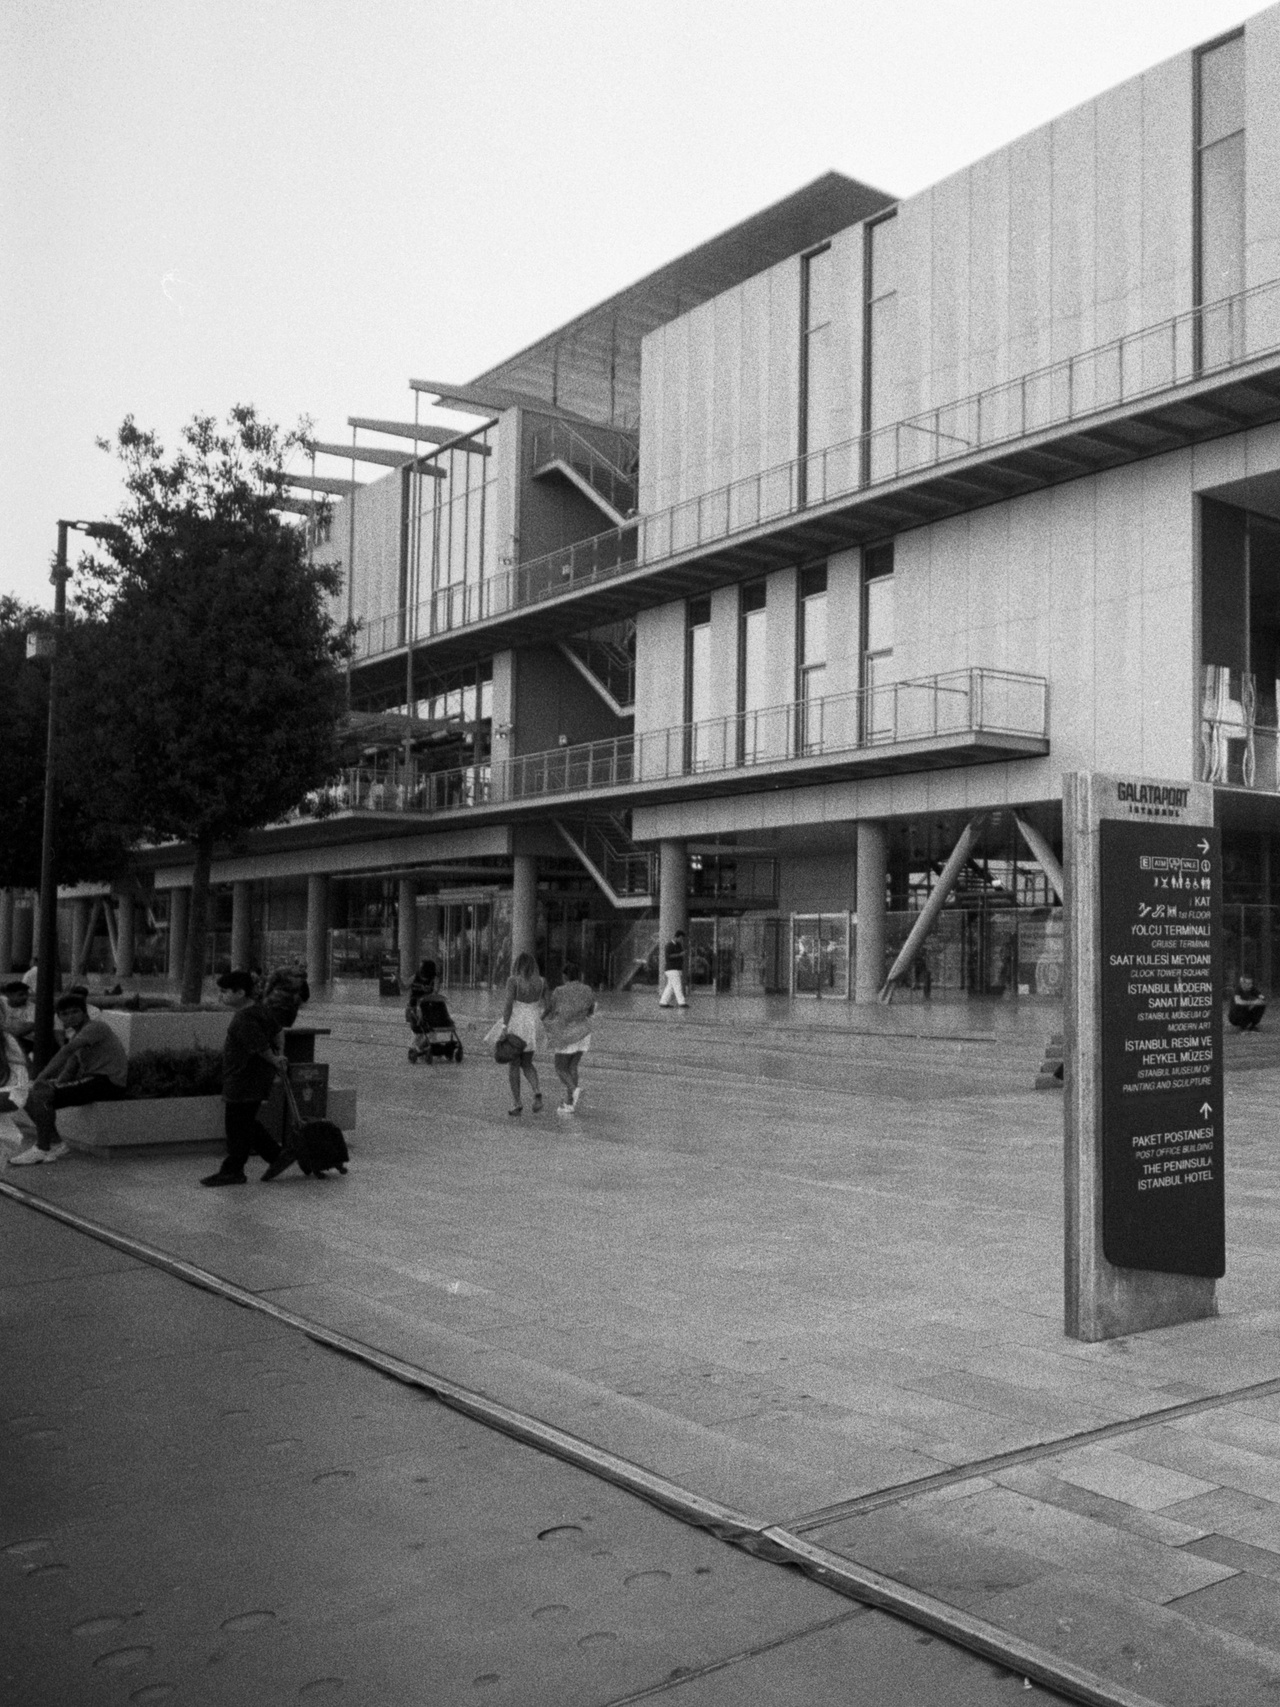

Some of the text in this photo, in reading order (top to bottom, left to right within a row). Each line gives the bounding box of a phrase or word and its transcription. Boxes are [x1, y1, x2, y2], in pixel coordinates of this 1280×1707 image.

[1118, 782, 1190, 808] GALATAPORT
[1194, 896, 1211, 907] KAT
[1188, 910, 1211, 919] FLOOR
[1131, 923, 1211, 936] YOLCU TERMİNALİ
[1151, 940, 1177, 948] CRUISE
[1109, 952, 1211, 966] SAAT KULESİ MEYDANI
[1130, 968, 1210, 978] CLOCK TOWER SQUARE
[1173, 982, 1213, 994] MODERN
[1148, 998, 1178, 1009] SANAT
[1167, 1022, 1212, 1032] MODERN ART
[1171, 1035, 1200, 1048] RESİM
[1200, 1035, 1213, 1046] VE
[1142, 1053, 1178, 1065] HEYKEL
[1122, 1077, 1211, 1093] PAINTING AND SCULPTURE
[1132, 1134, 1162, 1147] PAKET
[1136, 1142, 1214, 1159] POST OFFICE BUILDING
[1143, 1157, 1213, 1174] THE PENINSULA
[1184, 1170, 1214, 1184] HOTEL
